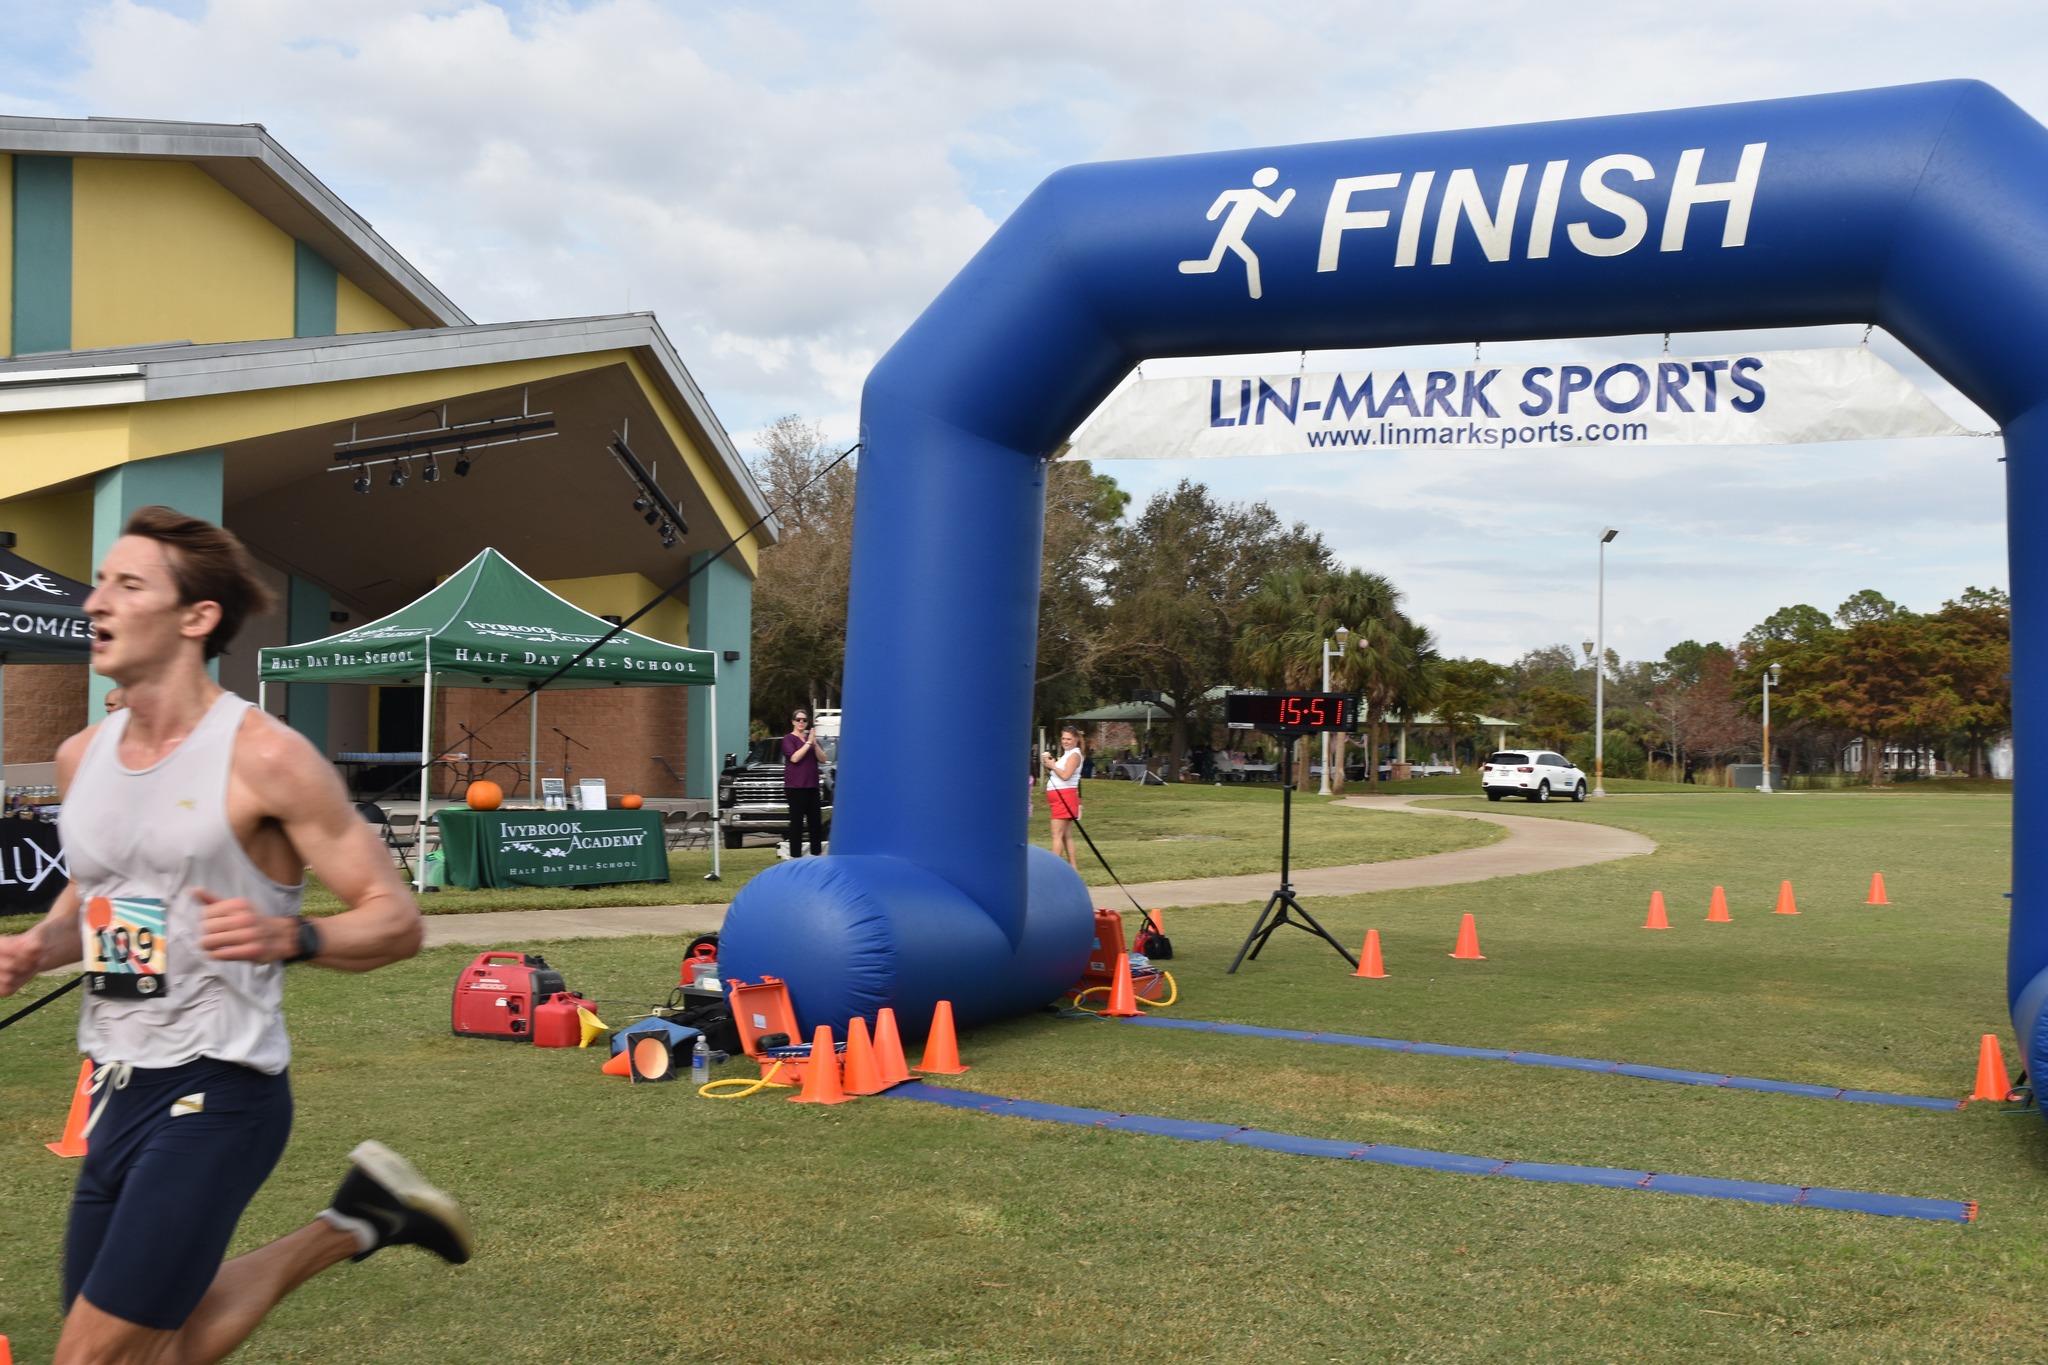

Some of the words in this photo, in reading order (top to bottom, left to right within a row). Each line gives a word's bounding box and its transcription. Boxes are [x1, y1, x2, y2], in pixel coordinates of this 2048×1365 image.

[1317, 142, 1767, 272] FINISH
[1209, 370, 1500, 428] LIN-MARK
[1519, 357, 1766, 417] SPORTS
[1307, 420, 1647, 449] www.linmarksports.com
[464, 620, 559, 635] IVYBROOK
[271, 657, 300, 669] HALF
[307, 655, 329, 668] DAY
[334, 651, 414, 666] PRE-SCHOOL
[455, 648, 509, 663] HALF
[524, 651, 561, 666] DAY
[500, 822, 583, 838] IVYBROOK
[570, 834, 645, 850] ACADEMY
[0, 837, 71, 892] LUX
[509, 868, 537, 876] HALF
[543, 865, 564, 873] DAY
[568, 861, 638, 871] PRE-SCHOOL
[97, 926, 153, 964] 109
